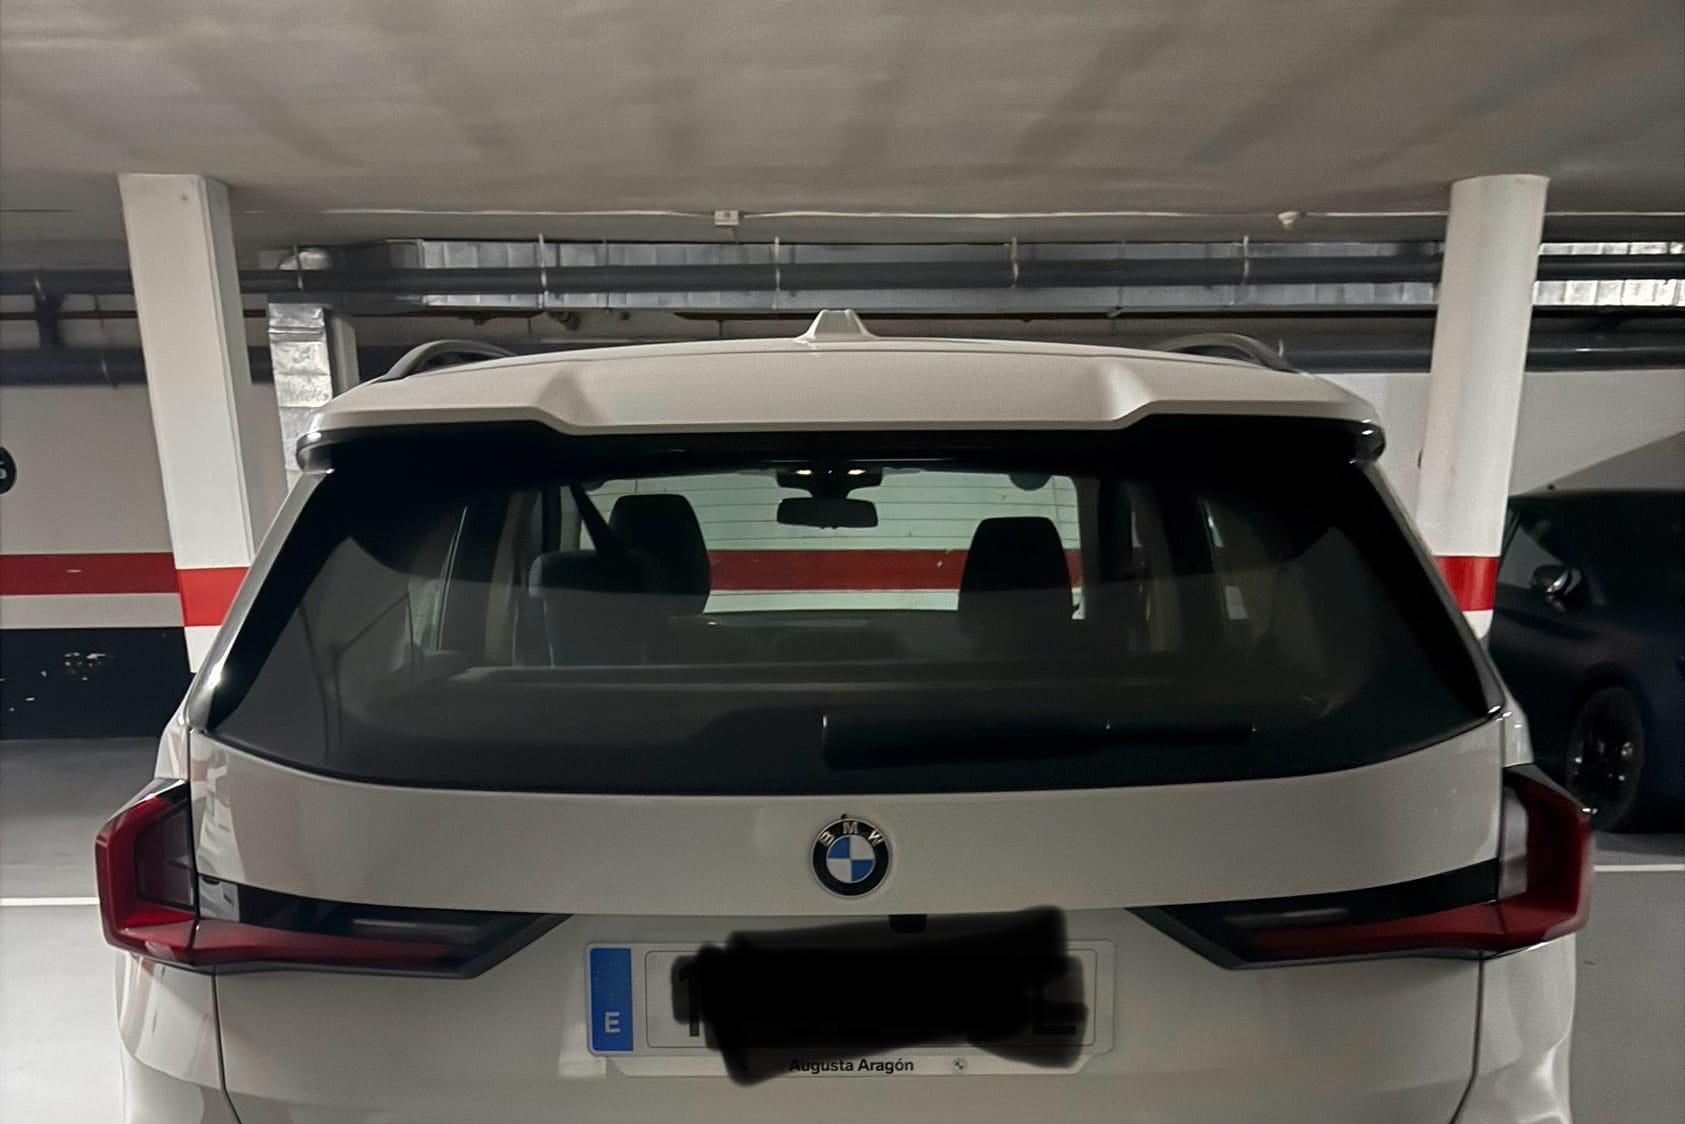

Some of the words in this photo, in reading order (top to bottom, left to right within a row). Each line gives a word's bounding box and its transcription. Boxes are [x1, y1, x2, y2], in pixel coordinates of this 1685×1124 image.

[819, 821, 884, 847] BMW
[604, 1011, 620, 1033] E
[789, 1058, 854, 1074] Augusta
[857, 1057, 914, 1074] Aragón
